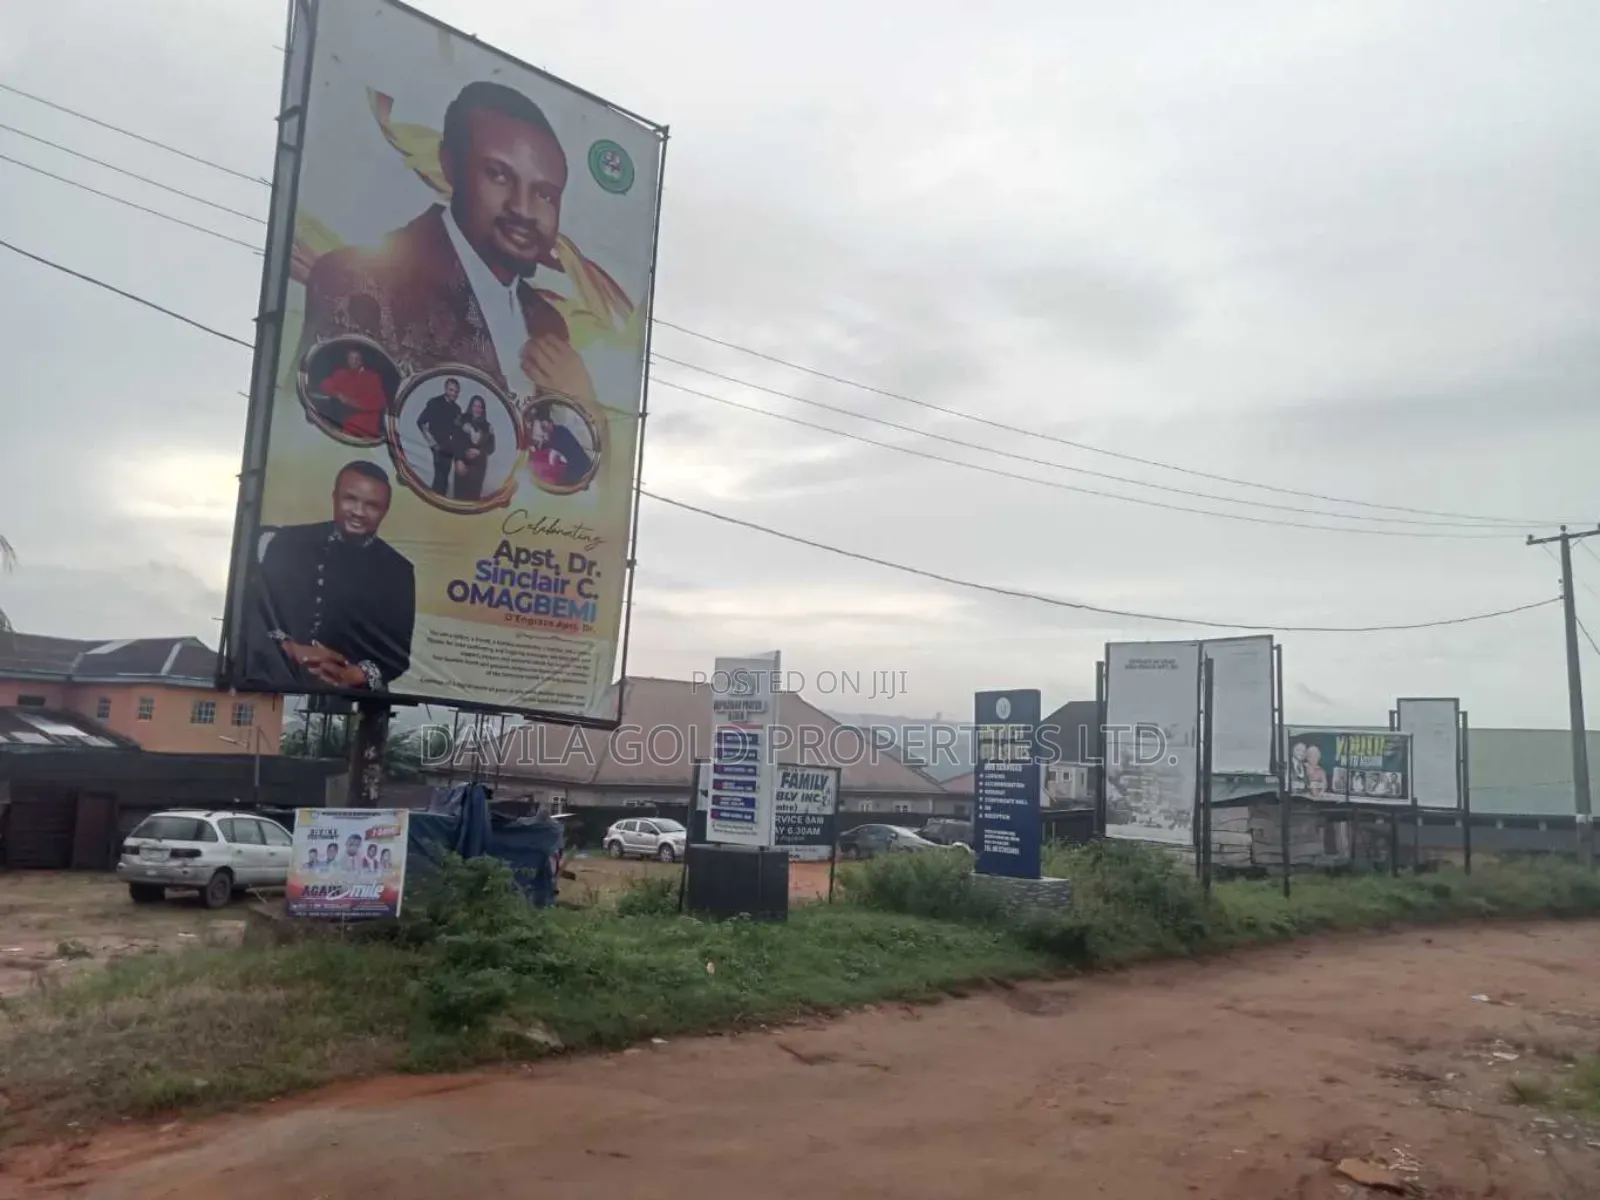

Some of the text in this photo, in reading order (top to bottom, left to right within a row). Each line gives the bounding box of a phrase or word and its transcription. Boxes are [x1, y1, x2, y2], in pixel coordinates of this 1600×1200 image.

[502, 509, 606, 551] Celebrating
[475, 559, 598, 600] Sinclair C.
[568, 552, 601, 578] Dr.
[446, 579, 597, 624] OMAGBEMI
[780, 771, 829, 791] FAMILY
[775, 816, 803, 825] RVICE
